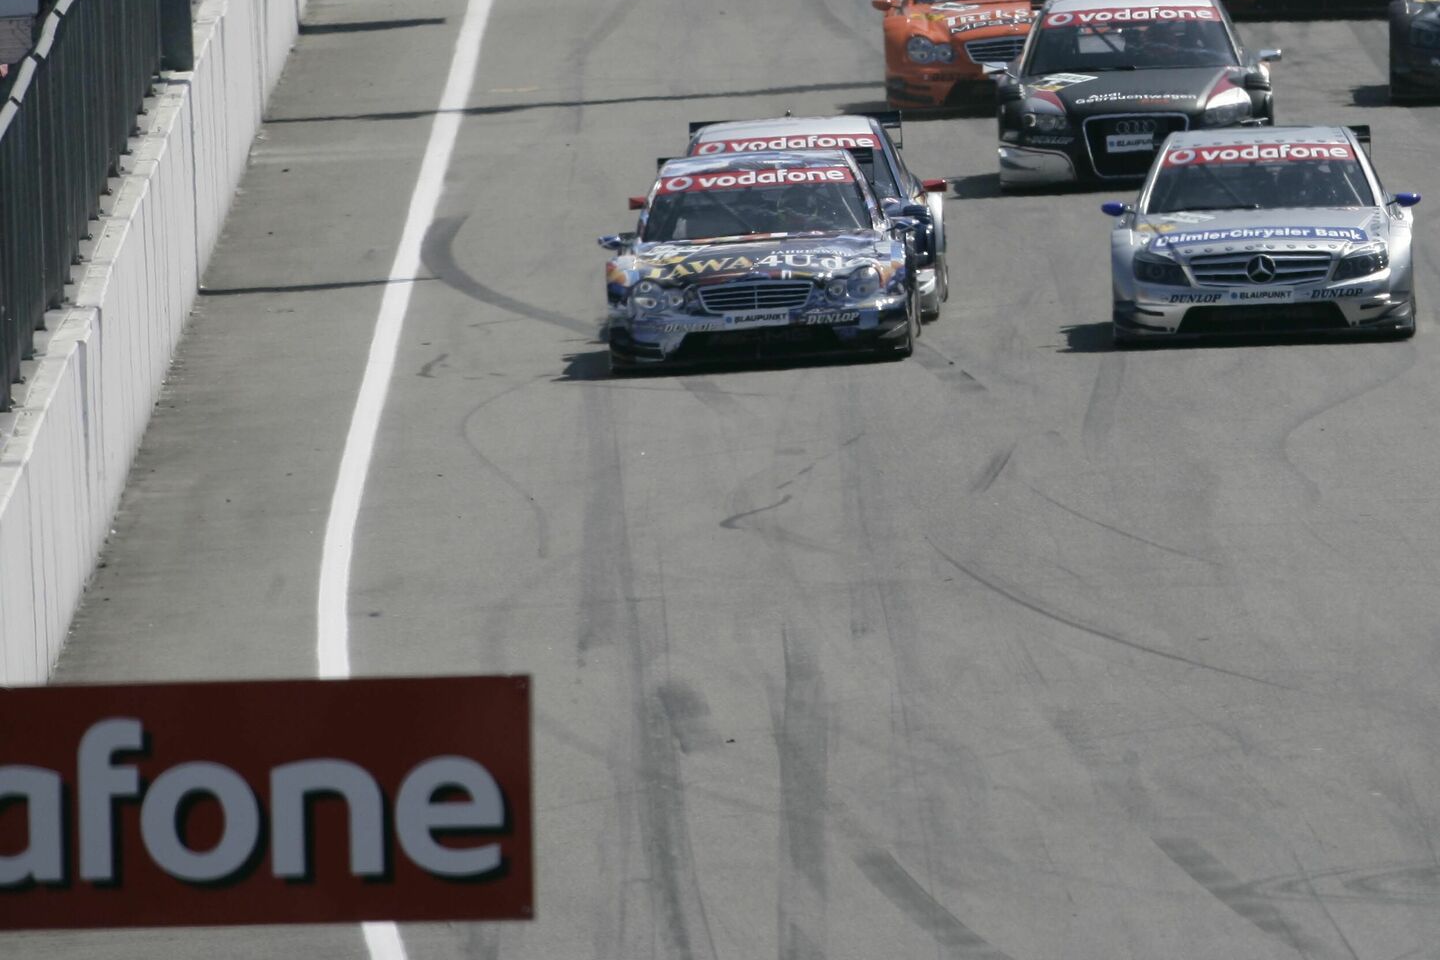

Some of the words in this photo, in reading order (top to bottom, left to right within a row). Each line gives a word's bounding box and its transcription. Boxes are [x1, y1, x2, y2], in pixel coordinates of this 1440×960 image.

[944, 8, 1040, 27] TREKST
[1078, 7, 1213, 23] vodafone
[731, 136, 873, 151] vodafone
[1201, 145, 1349, 161] vodafone
[699, 169, 845, 187] vodafone
[1156, 227, 1310, 247] DaimlerChrysler
[1316, 228, 1363, 241] Bank
[1169, 293, 1222, 303] DUNLOP
[1239, 291, 1292, 300] BLAUPUNKT
[1311, 288, 1363, 298] DUNLOP
[735, 313, 787, 324] BLAUPUNKT
[807, 312, 860, 325] DUNLOP
[0, 717, 504, 885] afone
